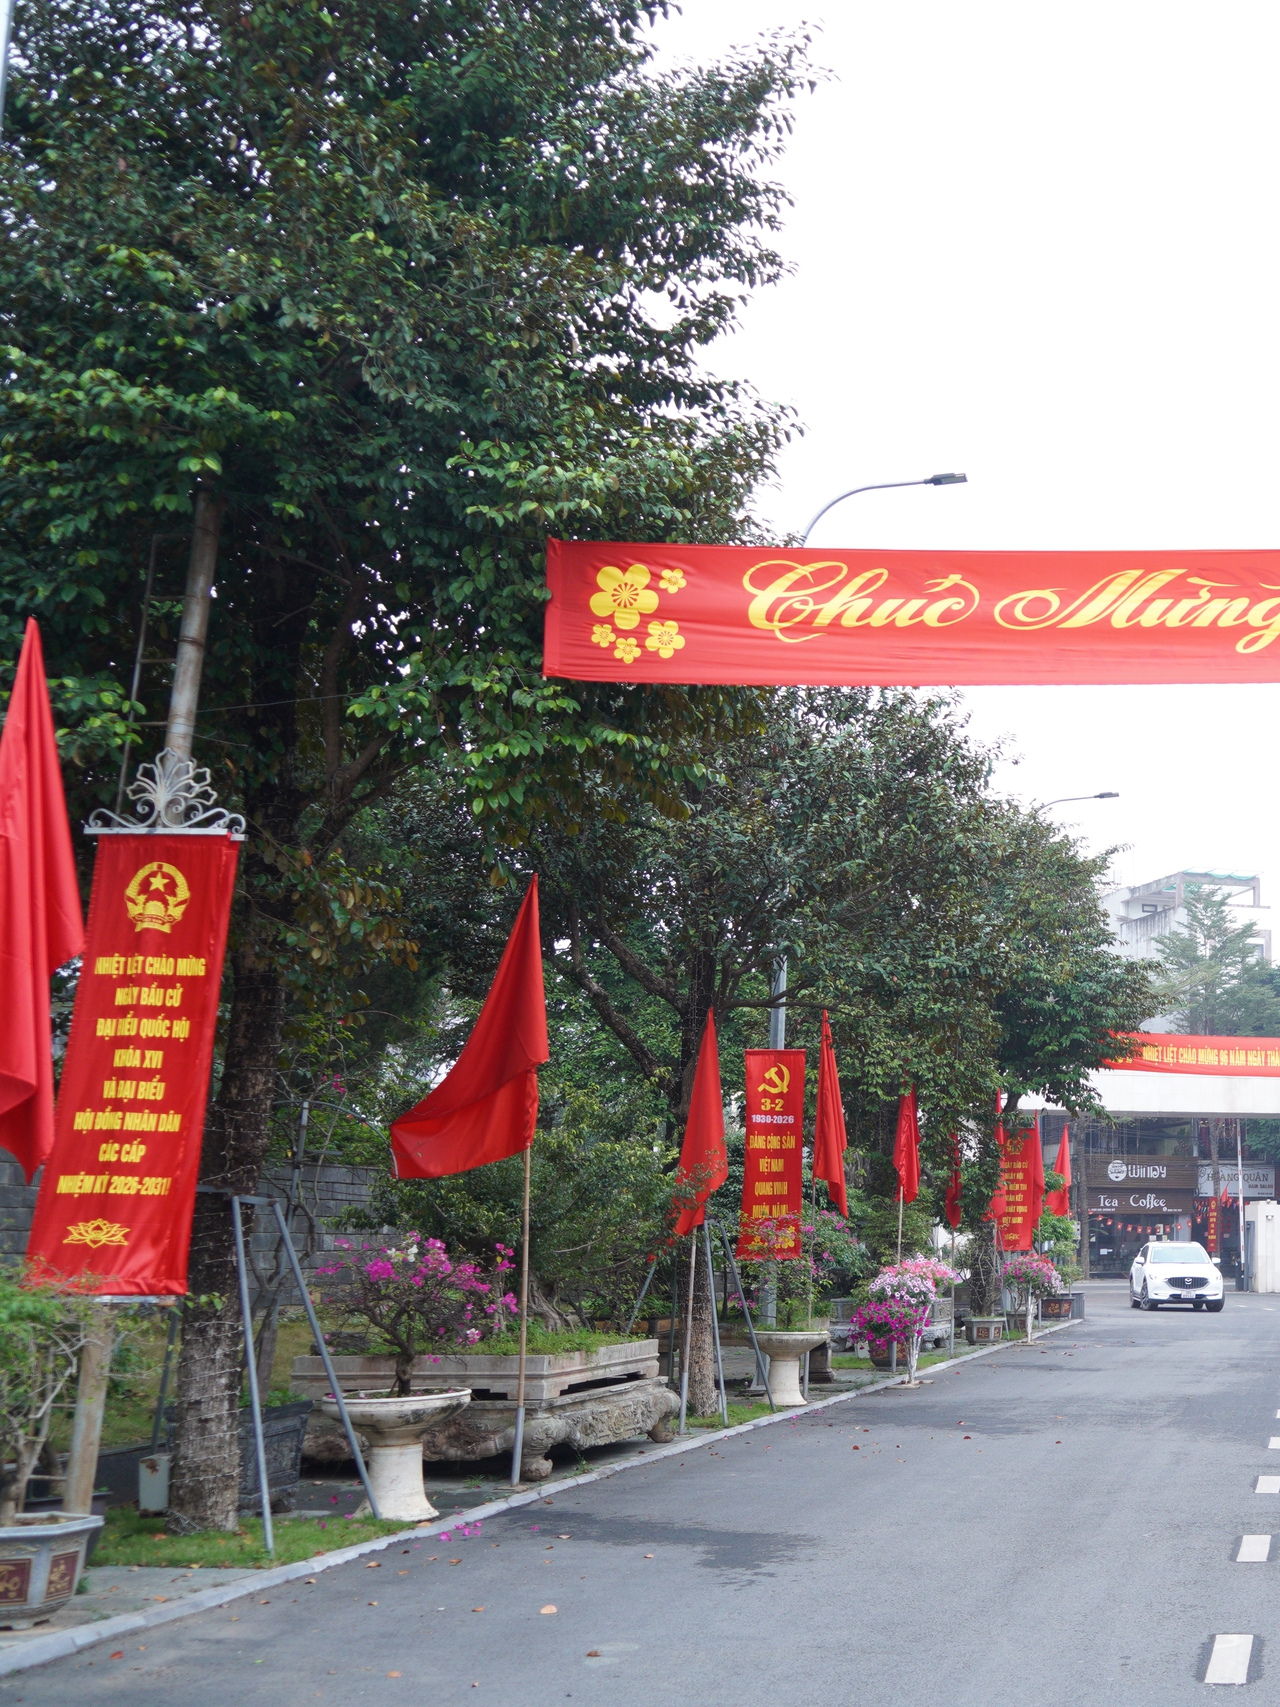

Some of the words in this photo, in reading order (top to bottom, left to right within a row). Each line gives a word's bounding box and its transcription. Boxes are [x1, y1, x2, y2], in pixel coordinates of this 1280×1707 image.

[742, 560, 980, 643] Chúc
[94, 952, 126, 979] NHIỆT
[145, 953, 175, 976] CHÀO
[176, 954, 206, 976] MỪNG
[140, 981, 165, 1006] BẦU
[165, 983, 184, 1008] CỬ
[96, 1018, 117, 1041] ĐẠI
[139, 1013, 171, 1038] QUỐC
[171, 1016, 191, 1043] HỘI
[113, 1045, 142, 1067] KHÓA
[142, 1050, 164, 1069] XVI
[1142, 1042, 1162, 1066] NHIỆT
[1163, 1043, 1177, 1067] LIỆT
[1178, 1044, 1197, 1065] CHÀO
[1198, 1045, 1218, 1066] MỪNG
[1219, 1050, 1228, 1066] 96
[1229, 1046, 1246, 1067] NĂM
[1247, 1046, 1265, 1067] NGÀY
[103, 1077, 117, 1099] VÀ
[116, 1080, 137, 1103] ĐẠI
[137, 1074, 166, 1101] BIỂU
[760, 1098, 784, 1112] 3-2
[73, 1108, 95, 1135] HỘI
[94, 1105, 124, 1130] ĐỒNG
[123, 1109, 158, 1131] NHÂN
[157, 1110, 182, 1132] DÂN
[751, 1114, 795, 1124] 1930-2026
[98, 1139, 121, 1162] CÁC
[120, 1137, 147, 1163] CẤP
[749, 1130, 766, 1149] ĐẢNG
[766, 1132, 781, 1152] CỘNG
[781, 1130, 796, 1150] SẢN
[759, 1156, 771, 1176] VIỆT
[770, 1158, 784, 1173] NAM
[1207, 1169, 1240, 1182] HÀNG
[1243, 1171, 1269, 1184] QUÂN
[56, 1171, 95, 1198] NHIỆM
[93, 1171, 110, 1194] KỲ
[108, 1176, 172, 1196] 2026-2031!
[754, 1181, 773, 1197] QUANG
[773, 1181, 788, 1195] VINH
[1098, 1194, 1119, 1207] Tea
[1129, 1193, 1167, 1210] Coffee
